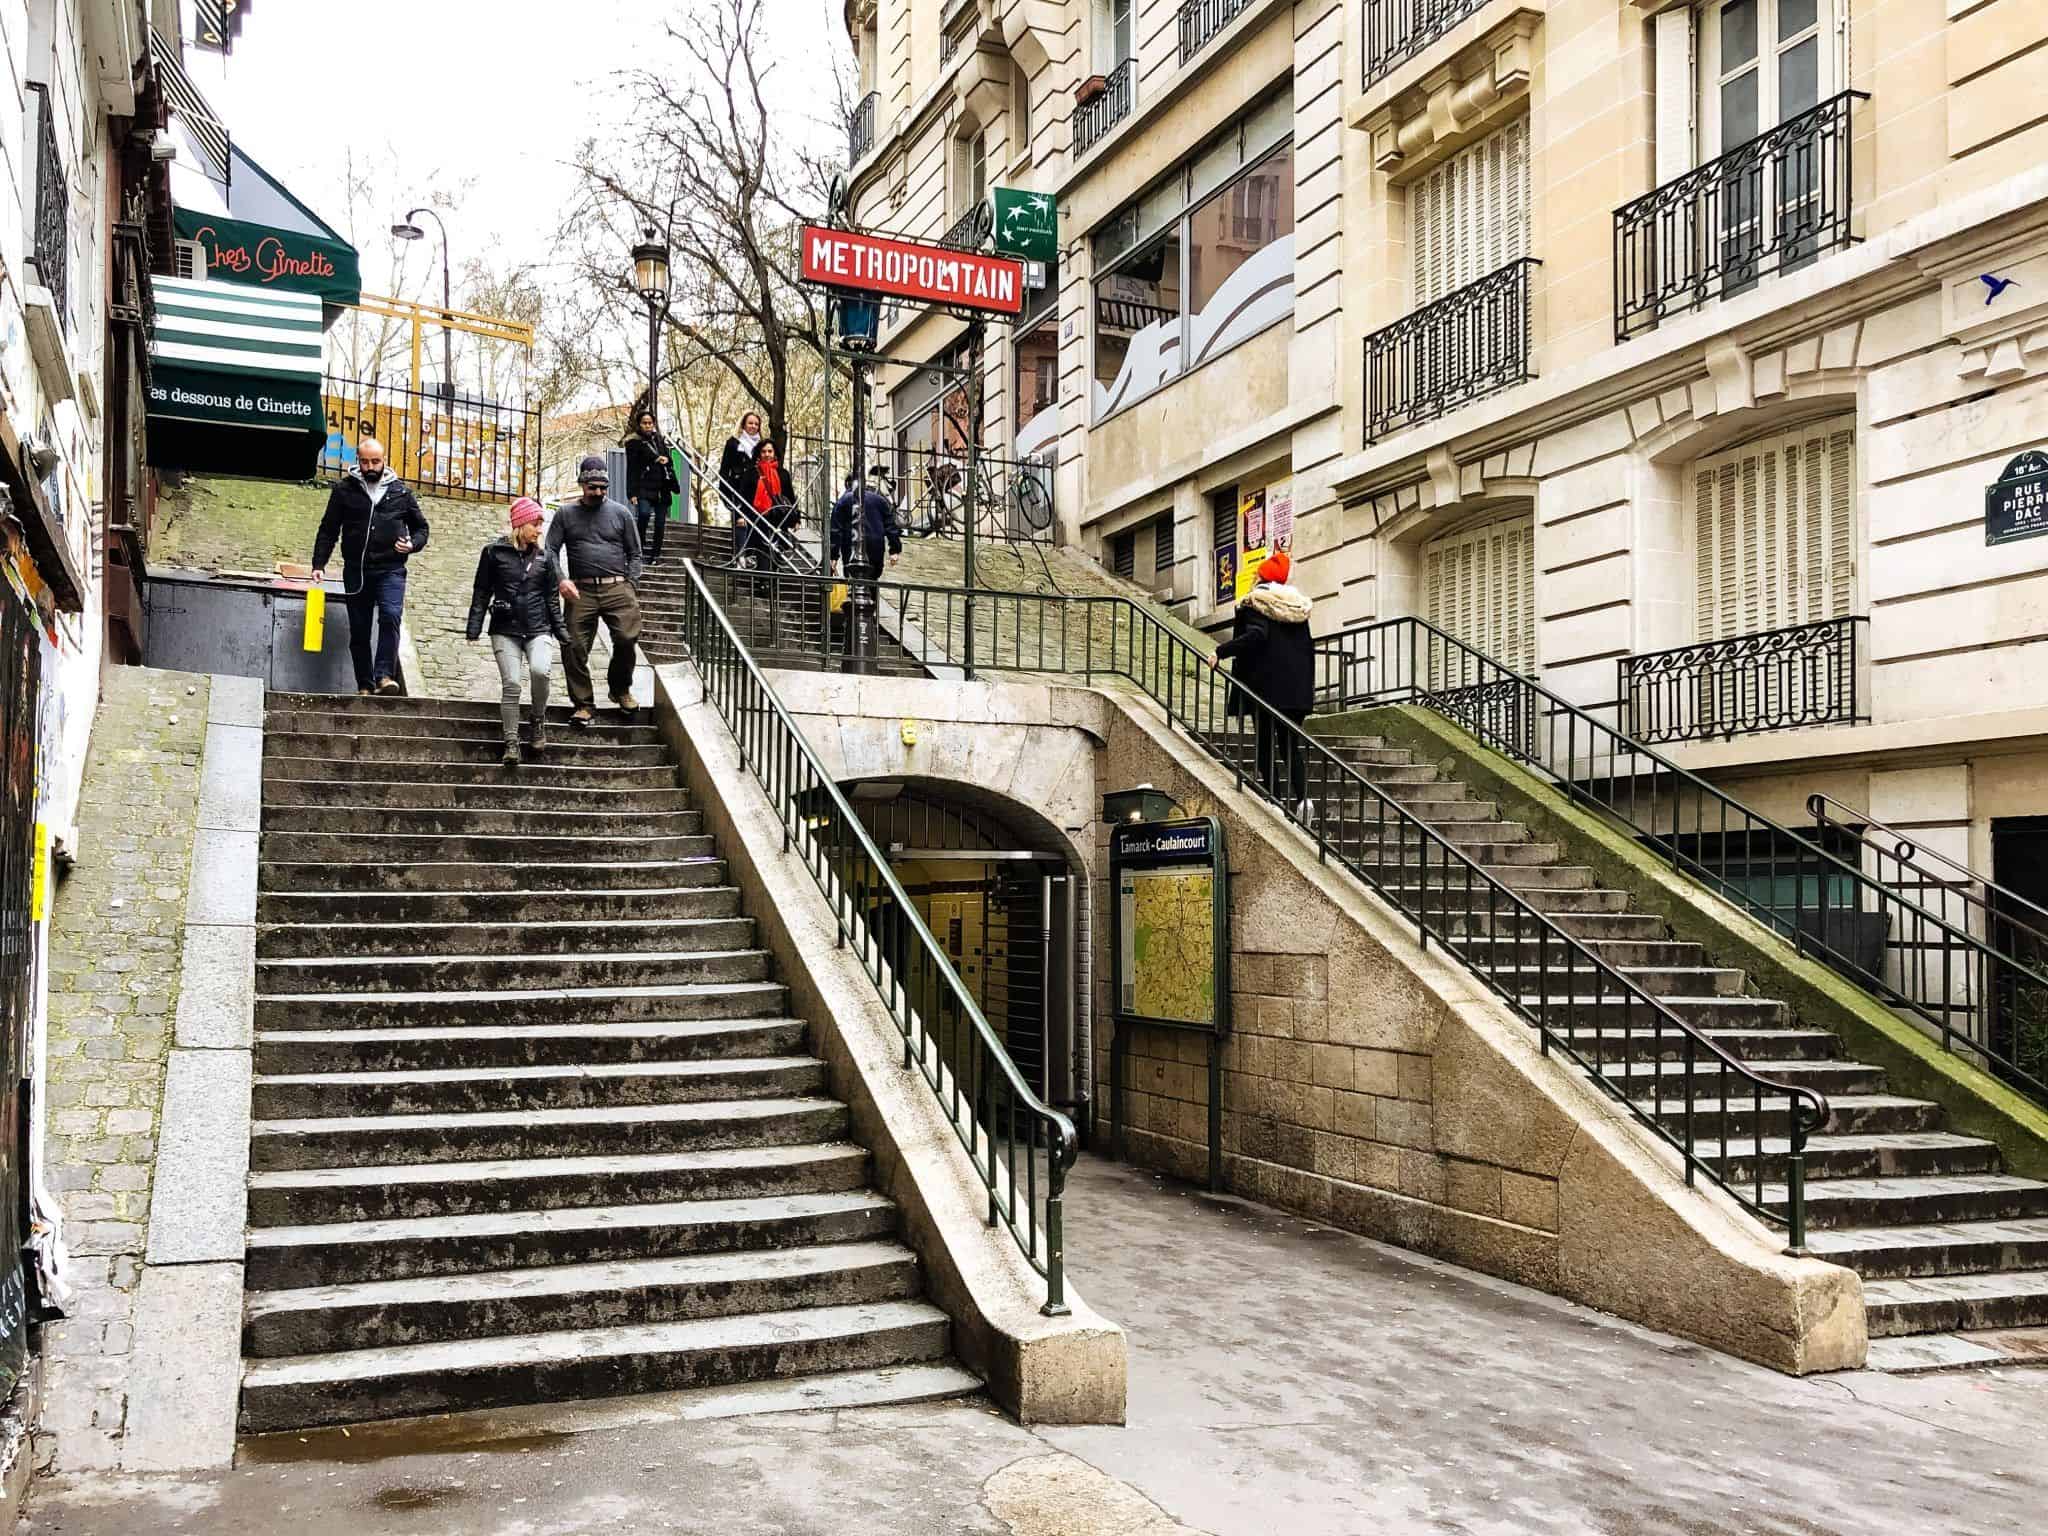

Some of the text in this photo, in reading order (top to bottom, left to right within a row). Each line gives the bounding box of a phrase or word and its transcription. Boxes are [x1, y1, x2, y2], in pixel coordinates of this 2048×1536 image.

[256, 236, 335, 282] Ginette
[811, 236, 1014, 302] METROPOLITAIN
[150, 387, 312, 416] es dessous de Ginette
[2015, 482, 2041, 498] RUE
[2015, 505, 2041, 521] DAC
